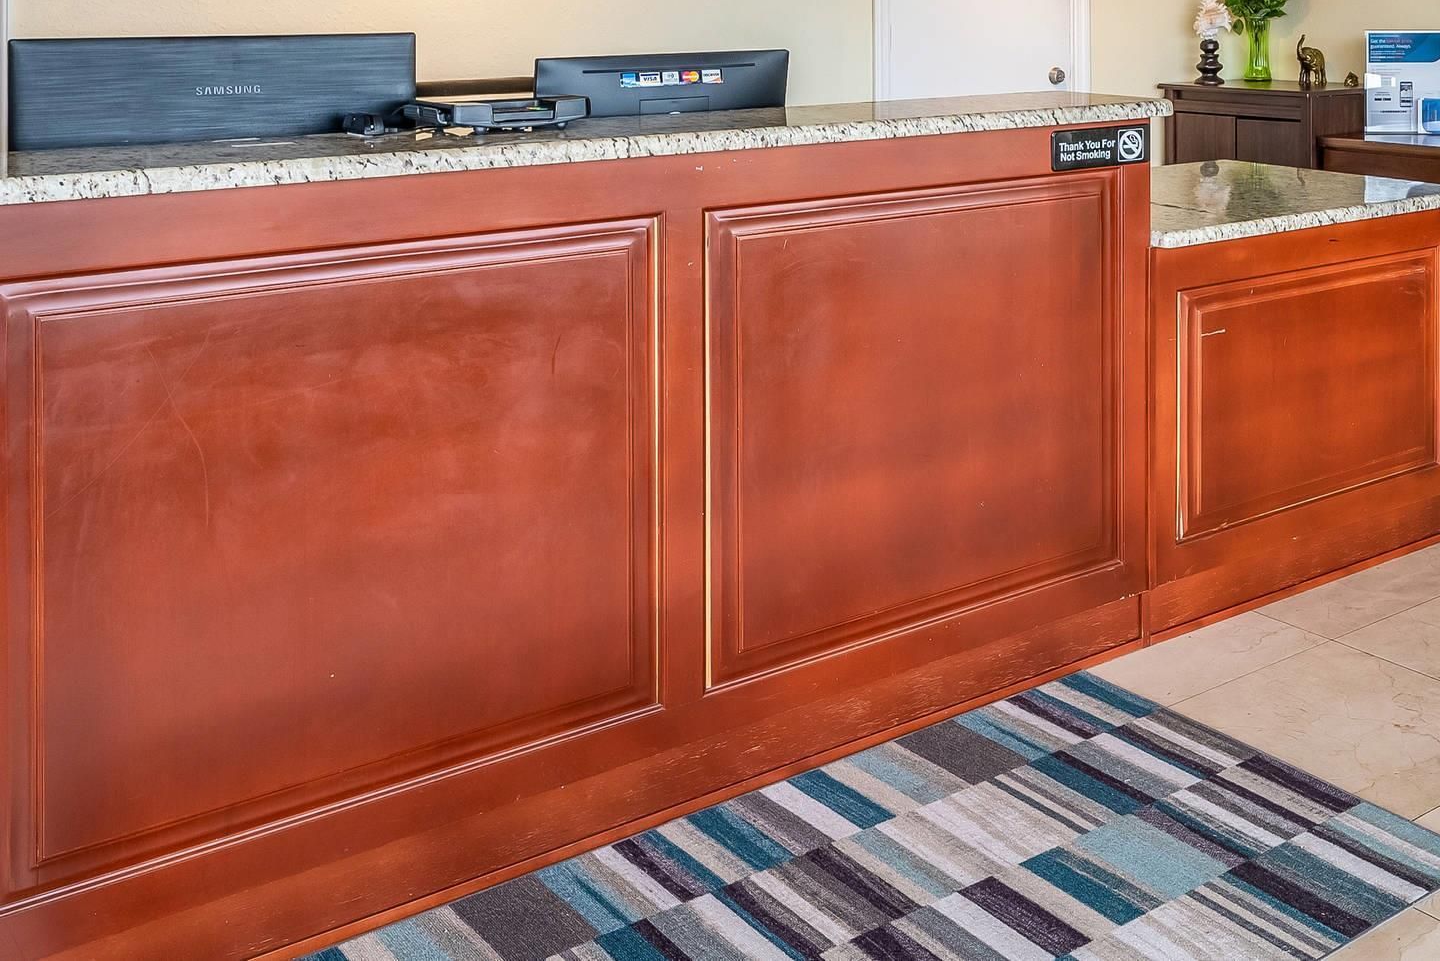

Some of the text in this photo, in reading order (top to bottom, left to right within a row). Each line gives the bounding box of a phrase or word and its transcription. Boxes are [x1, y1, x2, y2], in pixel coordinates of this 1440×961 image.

[196, 85, 261, 96] SAMSUNG
[1059, 138, 1116, 152] Thank You For
[1060, 149, 1111, 162] Not Smoking
